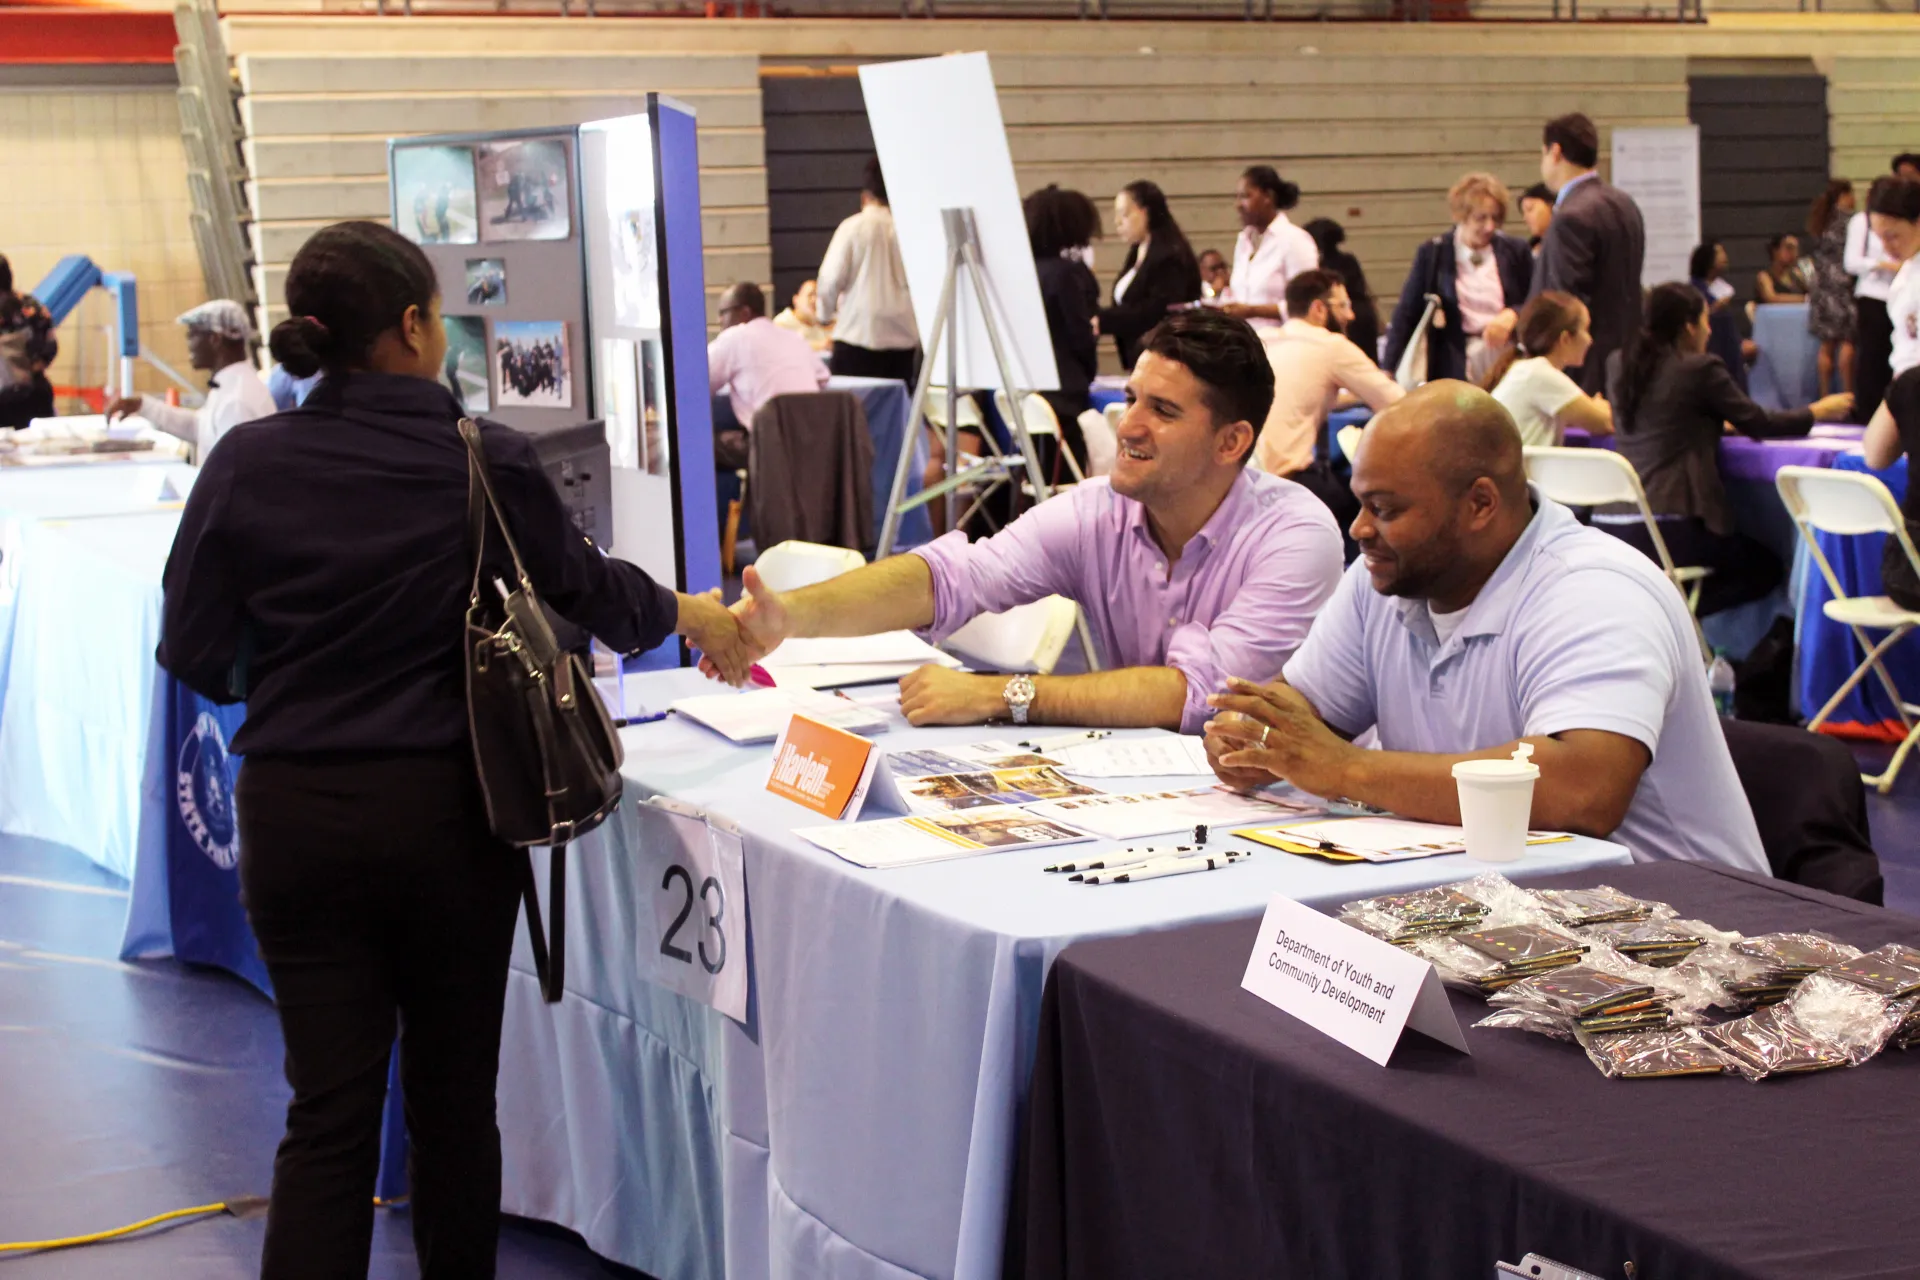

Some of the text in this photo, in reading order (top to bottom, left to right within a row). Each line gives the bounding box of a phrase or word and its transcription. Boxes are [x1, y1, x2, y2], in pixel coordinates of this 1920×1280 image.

[775, 742, 829, 796] Harlem
[660, 864, 727, 975] 23
[1268, 952, 1386, 1024] Community Development
[1276, 929, 1395, 1000] Department of Youth and
